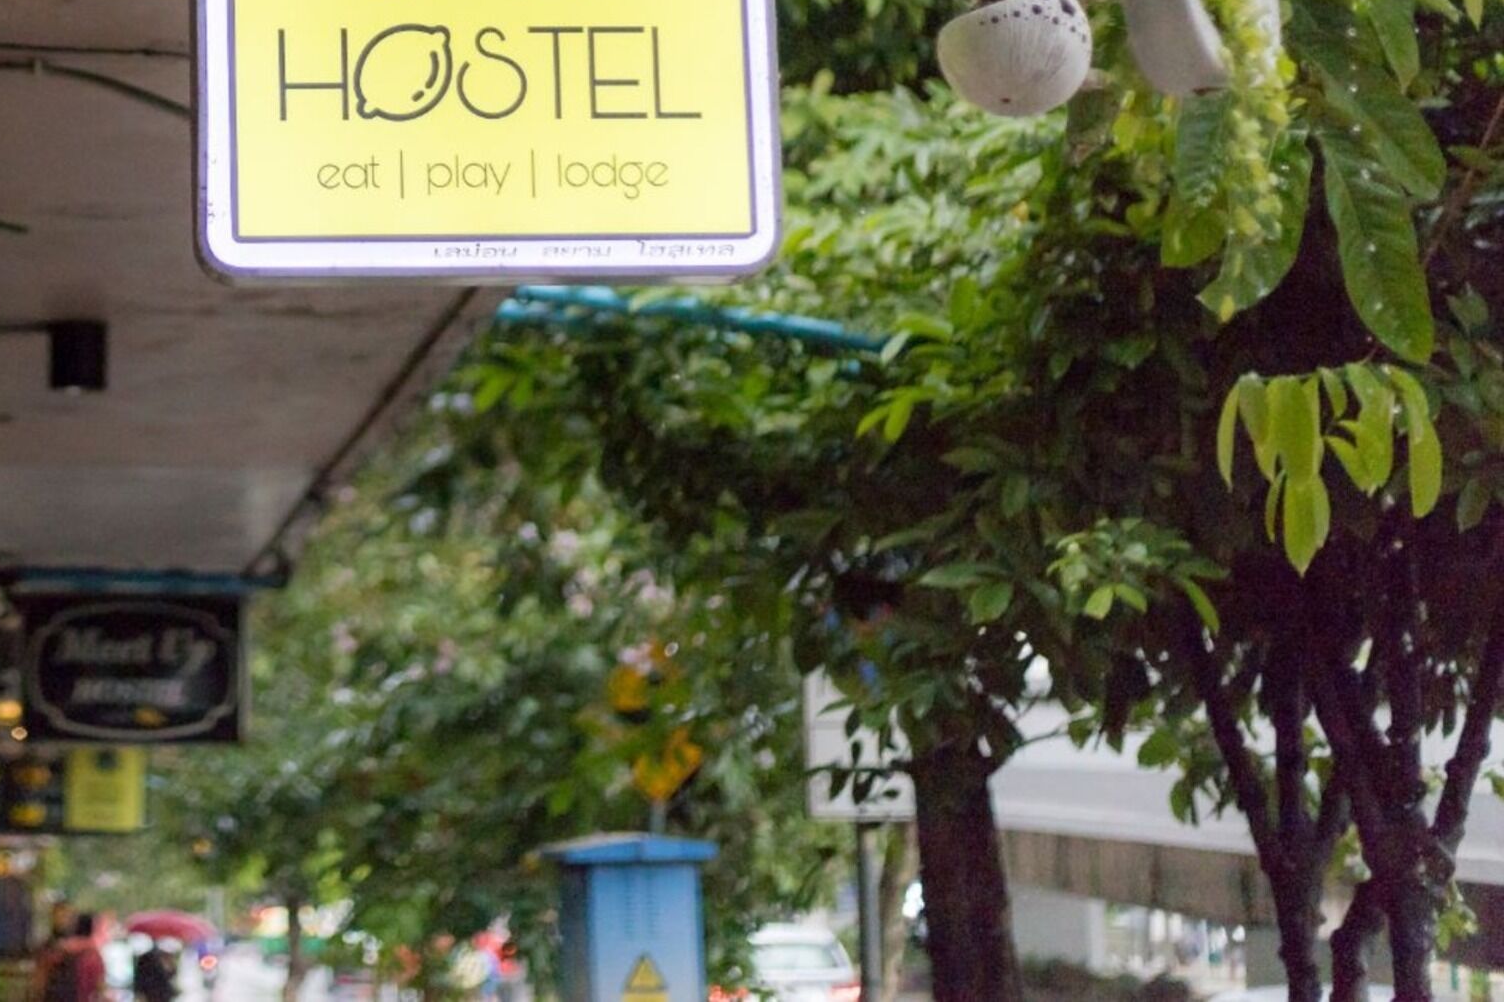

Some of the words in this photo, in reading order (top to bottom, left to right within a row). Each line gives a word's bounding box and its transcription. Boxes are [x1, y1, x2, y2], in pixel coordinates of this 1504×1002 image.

[277, 22, 703, 123] HOSTEL
[315, 154, 382, 191] eat
[425, 153, 512, 197] play
[555, 152, 670, 202] lodge
